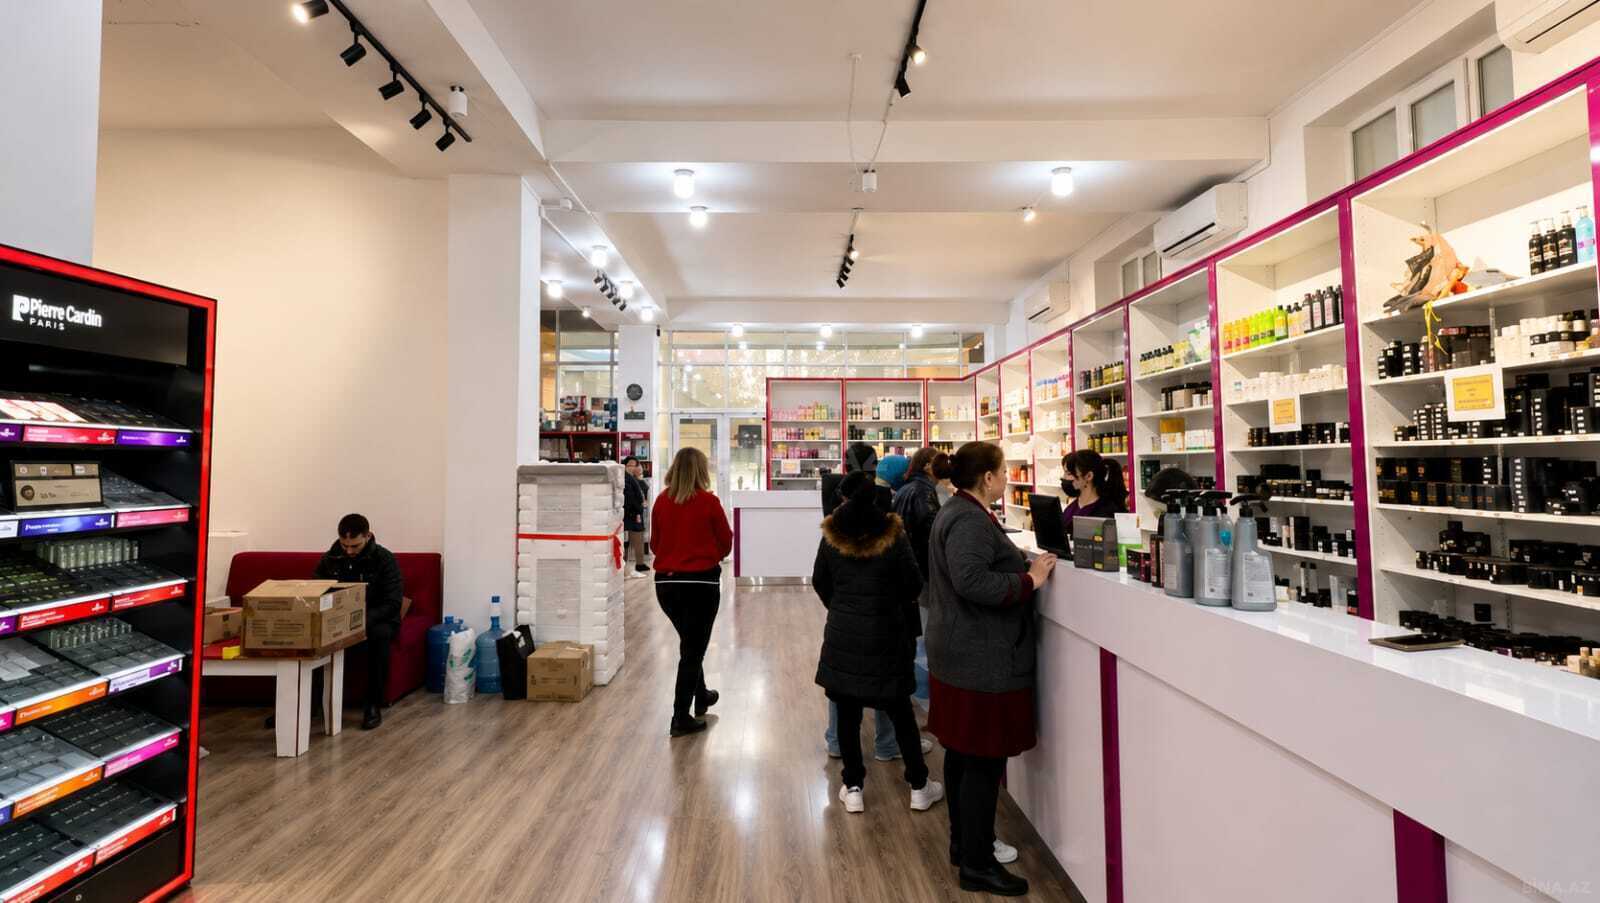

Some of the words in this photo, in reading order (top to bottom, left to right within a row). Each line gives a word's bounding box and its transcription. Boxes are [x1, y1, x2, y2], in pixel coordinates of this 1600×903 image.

[30, 298, 65, 321] Pierre
[66, 305, 102, 327] Cardin
[29, 317, 65, 331] PARIS
